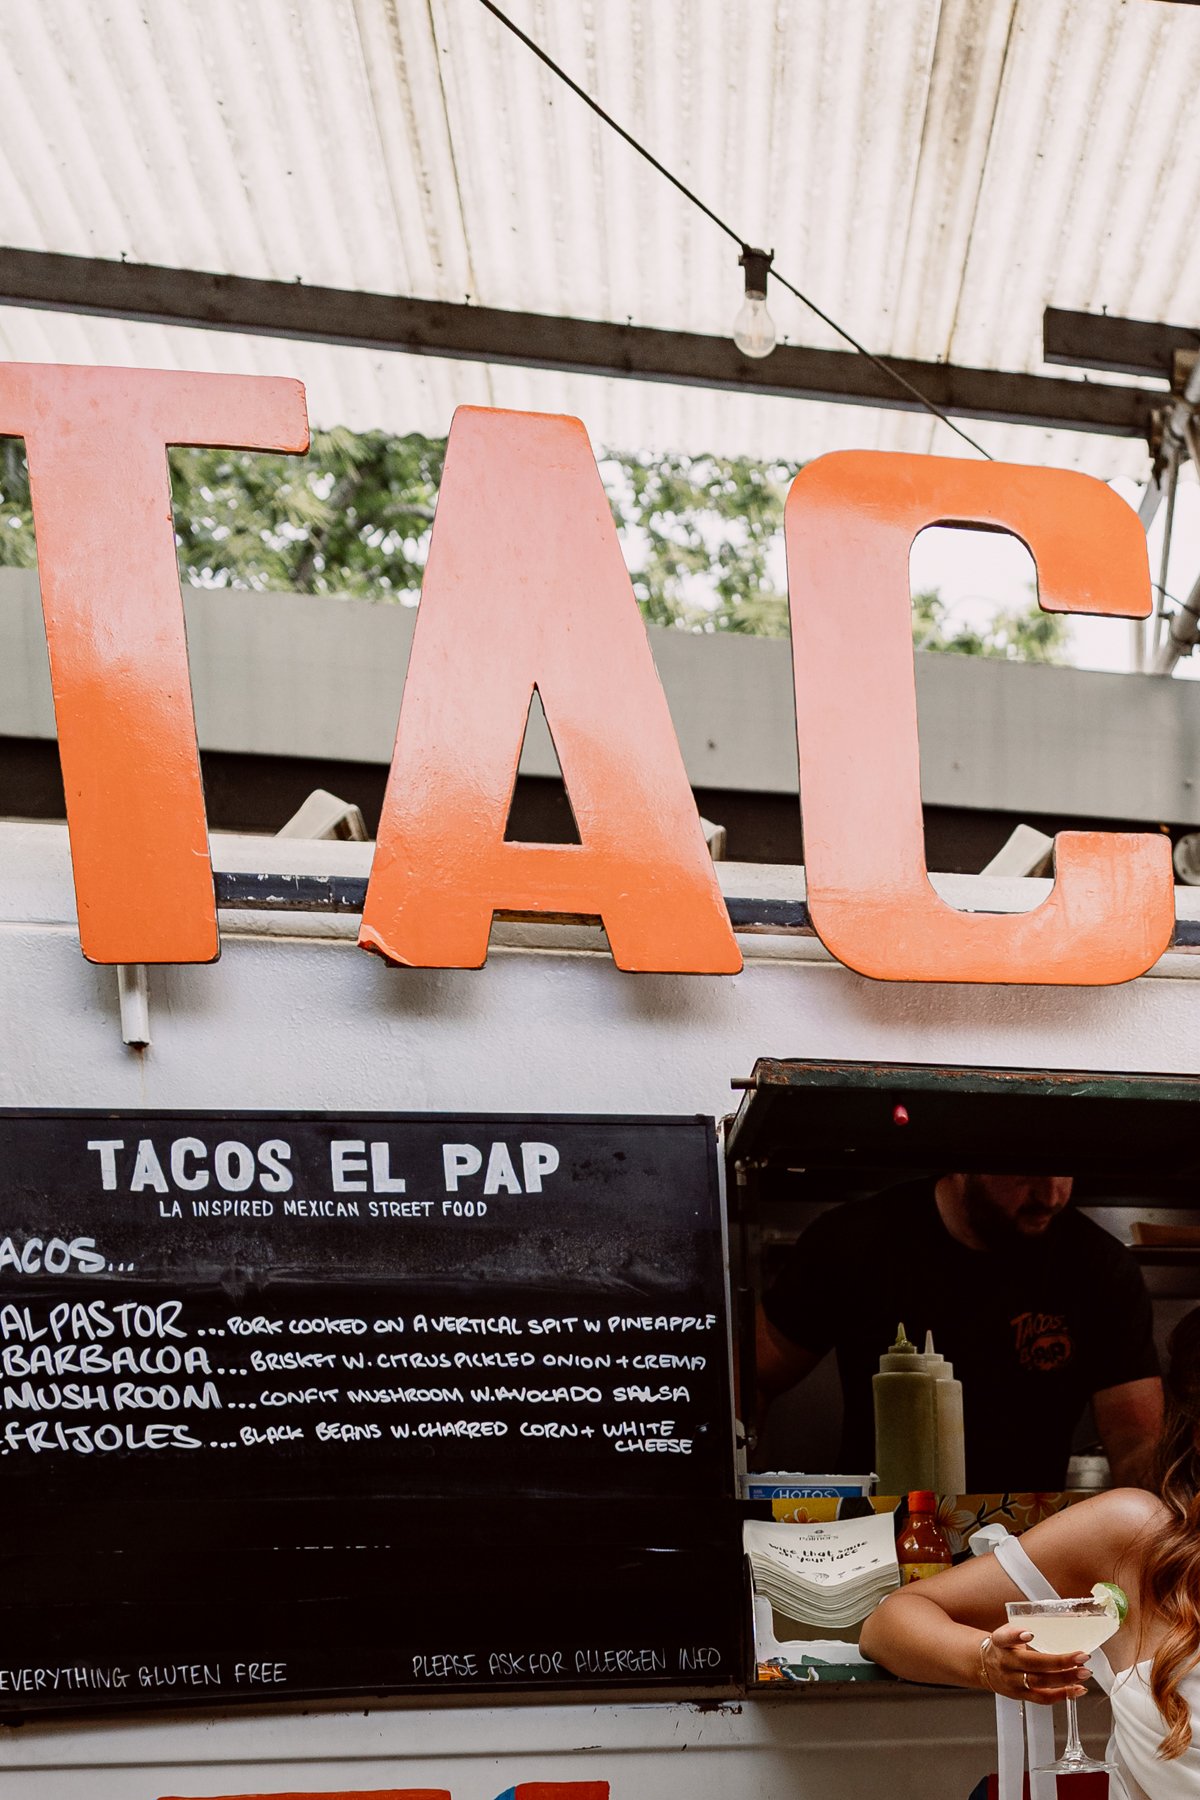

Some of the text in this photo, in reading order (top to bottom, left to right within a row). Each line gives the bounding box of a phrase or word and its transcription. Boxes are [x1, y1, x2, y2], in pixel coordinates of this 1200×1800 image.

[87, 1137, 560, 1195] TACOS EL PAP
[159, 1200, 487, 1218] LA INSPIRED MEXICAN STREET FOOD
[1, 1303, 48, 1342] AL
[227, 1316, 284, 1336] PORK
[288, 1317, 368, 1335] COOKED
[373, 1317, 405, 1334] ON
[413, 1314, 428, 1333] A
[431, 1316, 522, 1335] VERTICAL
[528, 1317, 578, 1334] SPIT
[583, 1318, 601, 1334] W
[250, 1350, 337, 1372] BRISKET
[542, 1353, 611, 1369] ONION
[259, 1388, 340, 1407] CONFIT
[346, 1387, 464, 1403] MUSHROOM
[612, 1385, 691, 1403] SALSA
[239, 1426, 305, 1447] BLACK
[314, 1421, 383, 1442] BEANS
[602, 1420, 676, 1438] WHITE
[614, 1439, 694, 1454] CHEESE
[412, 1647, 722, 1678] PLEASE ASK FOR ALLERGEN INFO
[0, 1662, 288, 1692] EVERYTHING GLUTEN FREE
